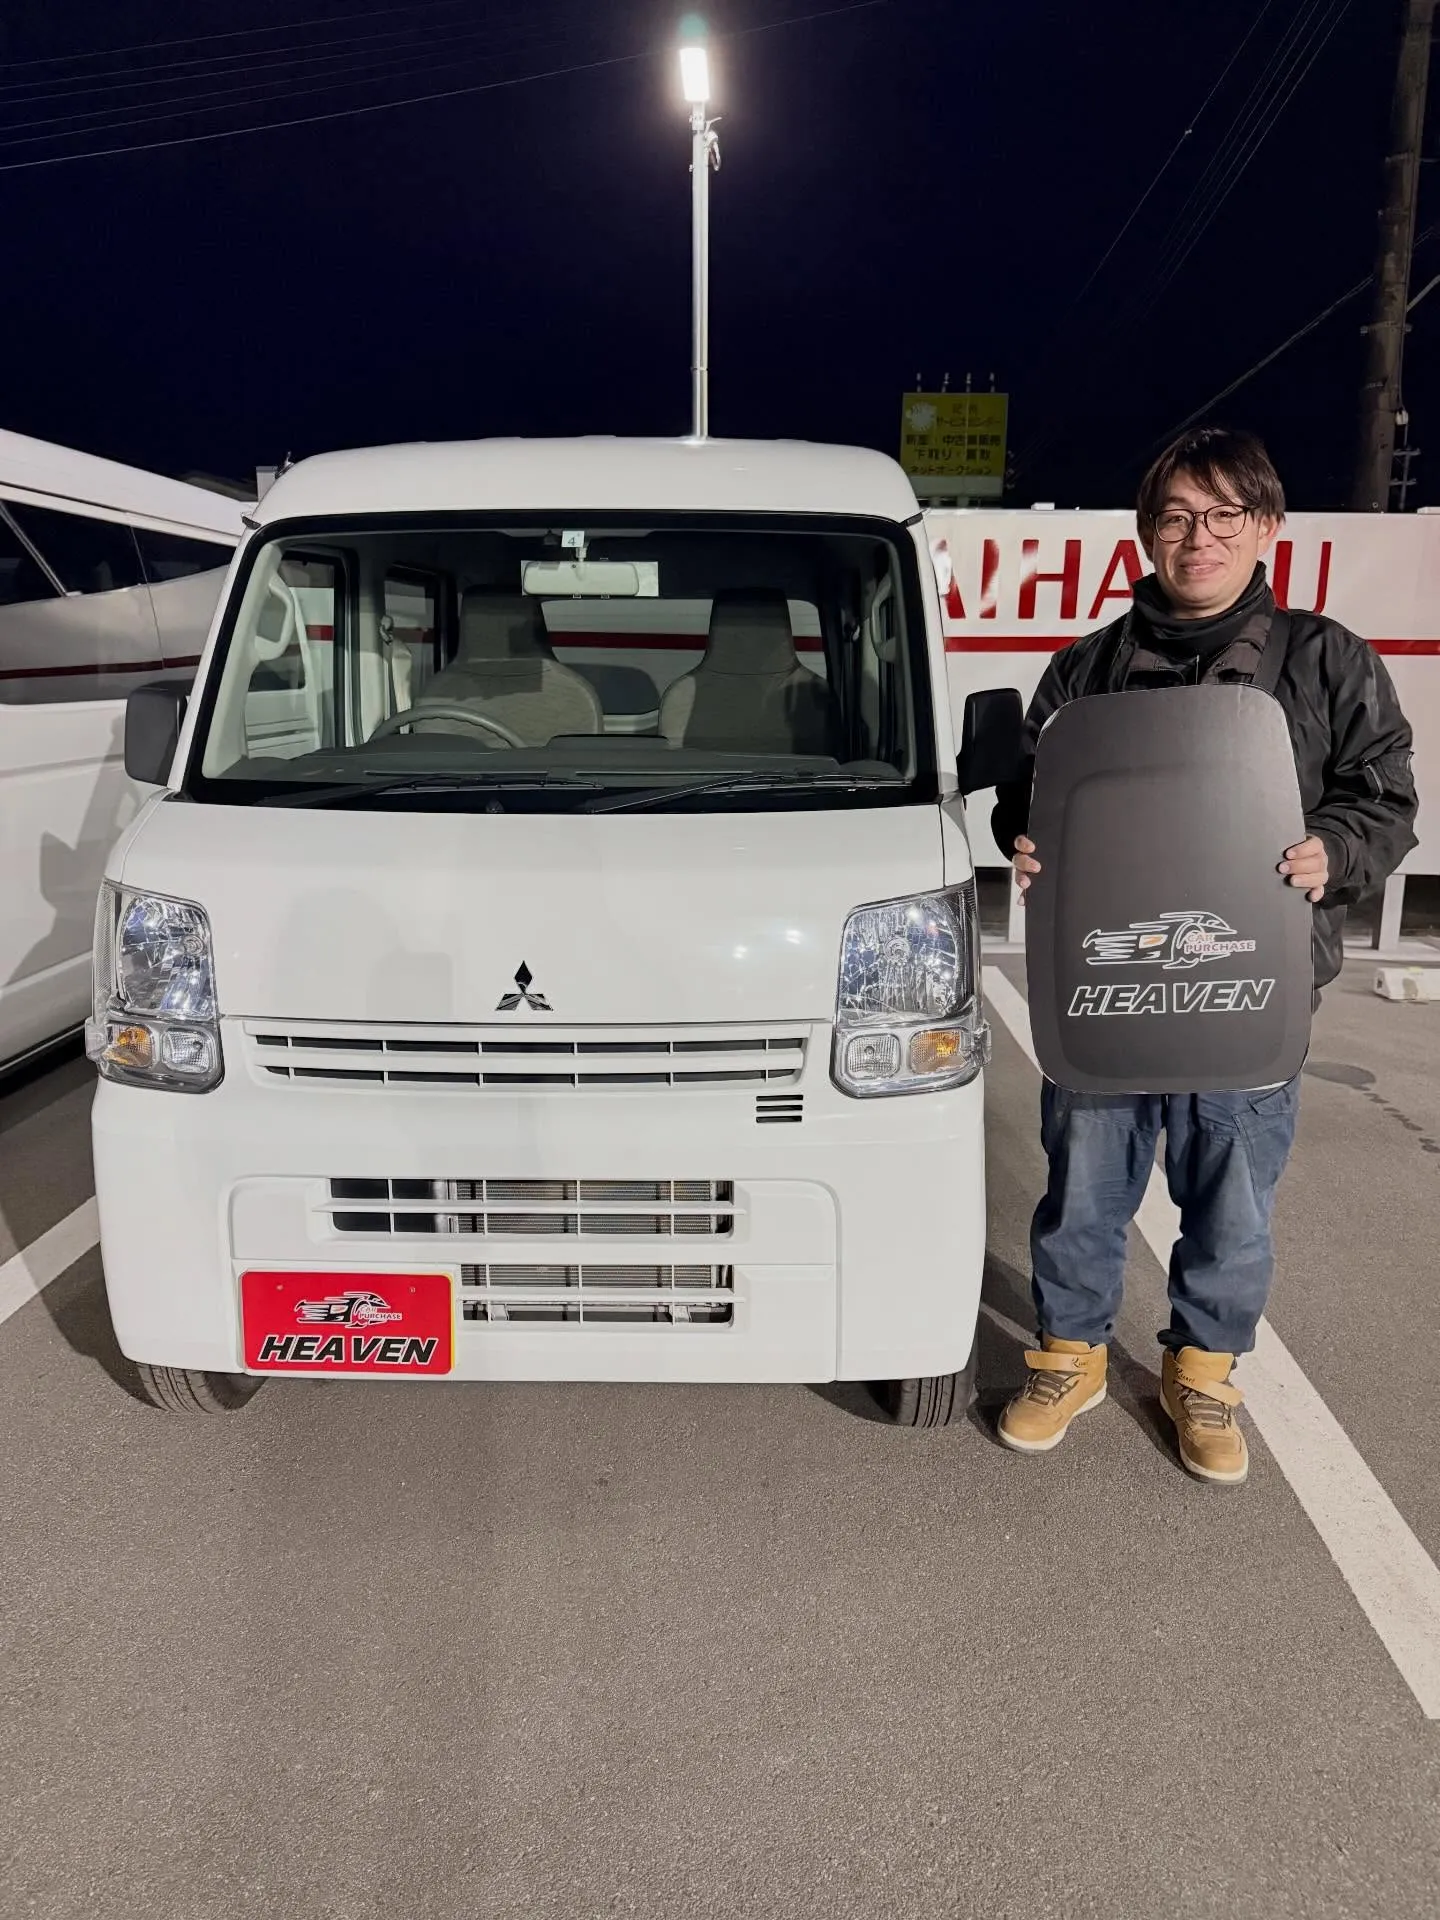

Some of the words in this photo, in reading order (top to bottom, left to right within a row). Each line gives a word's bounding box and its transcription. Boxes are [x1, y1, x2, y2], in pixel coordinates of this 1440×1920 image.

[1187, 932, 1216, 942] CAR
[1184, 940, 1256, 954] PURCHASE
[1068, 979, 1275, 1016] HEAVEN
[359, 1312, 402, 1320] PURCHASE
[257, 1335, 439, 1365] HEAVEN
